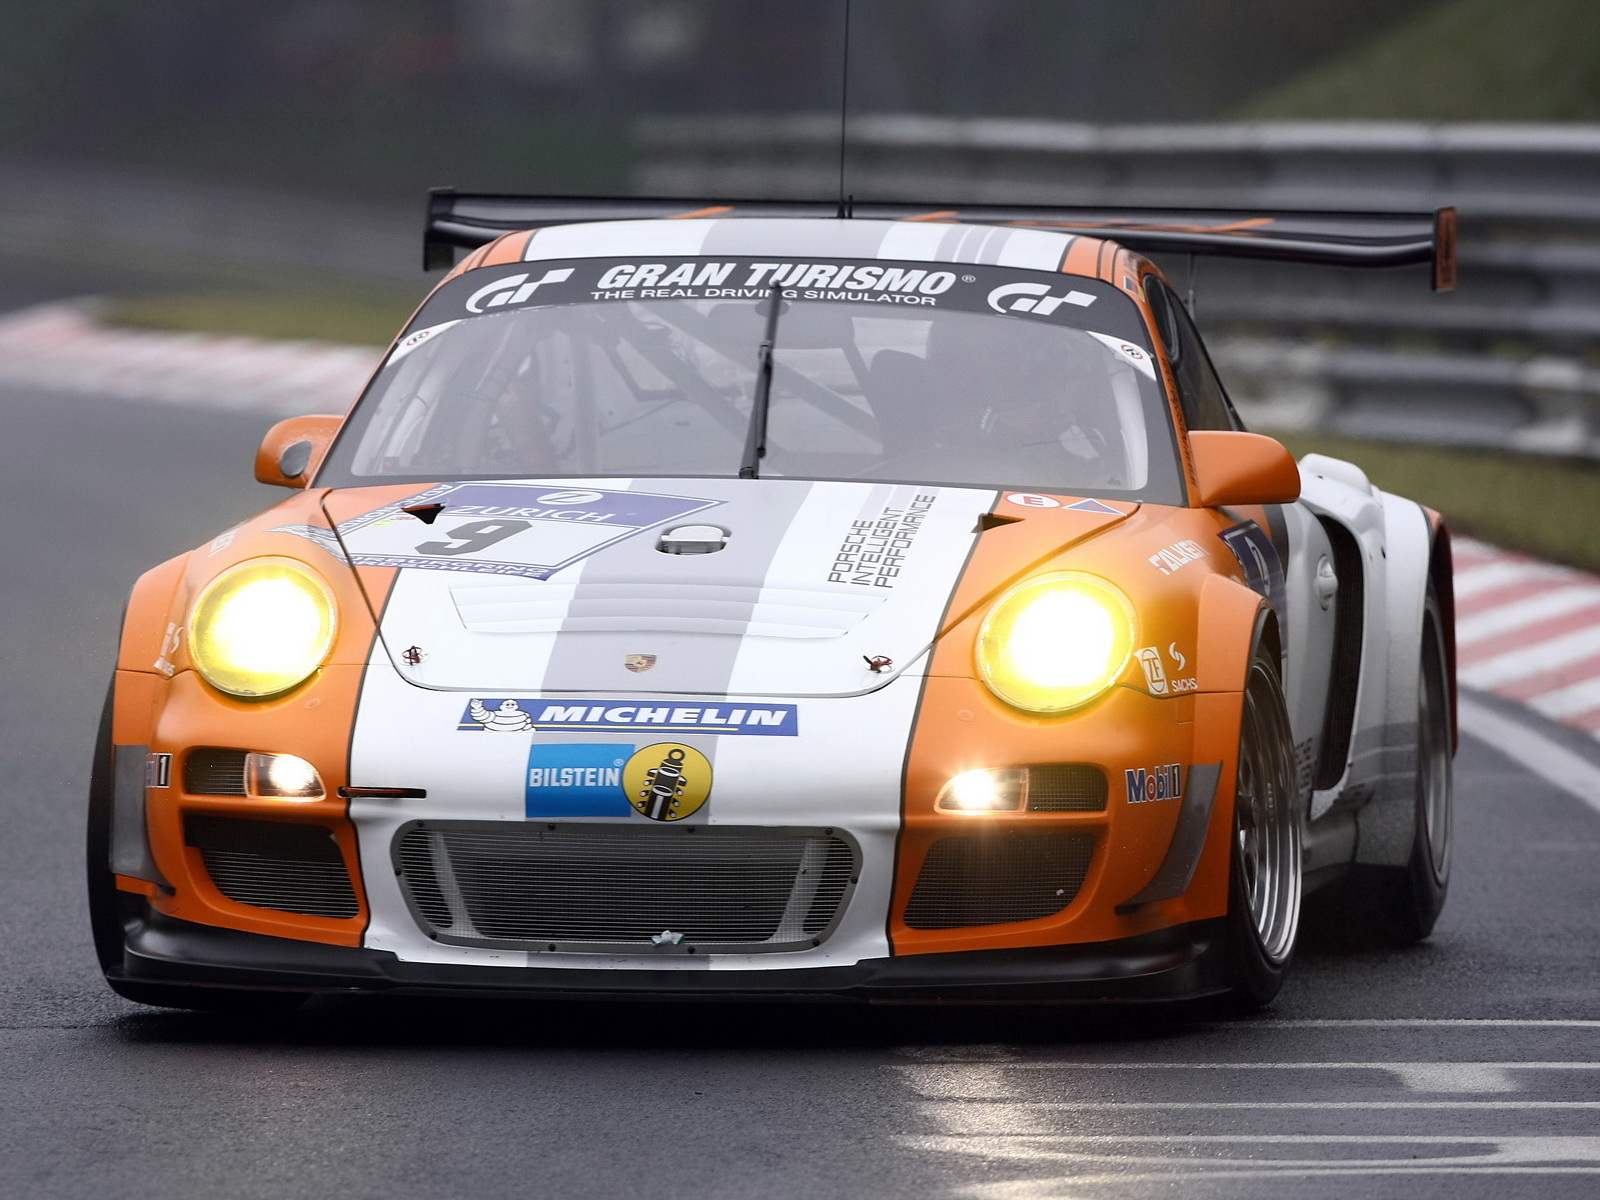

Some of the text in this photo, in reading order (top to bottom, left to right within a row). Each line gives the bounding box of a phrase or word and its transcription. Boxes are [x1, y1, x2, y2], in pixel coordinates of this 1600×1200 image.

[597, 263, 736, 289] GRAN
[743, 263, 956, 295] TURISMO
[590, 290, 635, 300] THE
[640, 289, 699, 299] REAL
[803, 289, 937, 306] SIMULATOR
[450, 505, 617, 522] ZURICH
[416, 519, 534, 556] 9
[827, 520, 874, 583] PORSCHE
[850, 507, 905, 586] INTELLIGENT
[873, 494, 937, 588] PERFORMANCE
[1171, 677, 1198, 692] SACHS
[538, 706, 788, 727] MICHELIN
